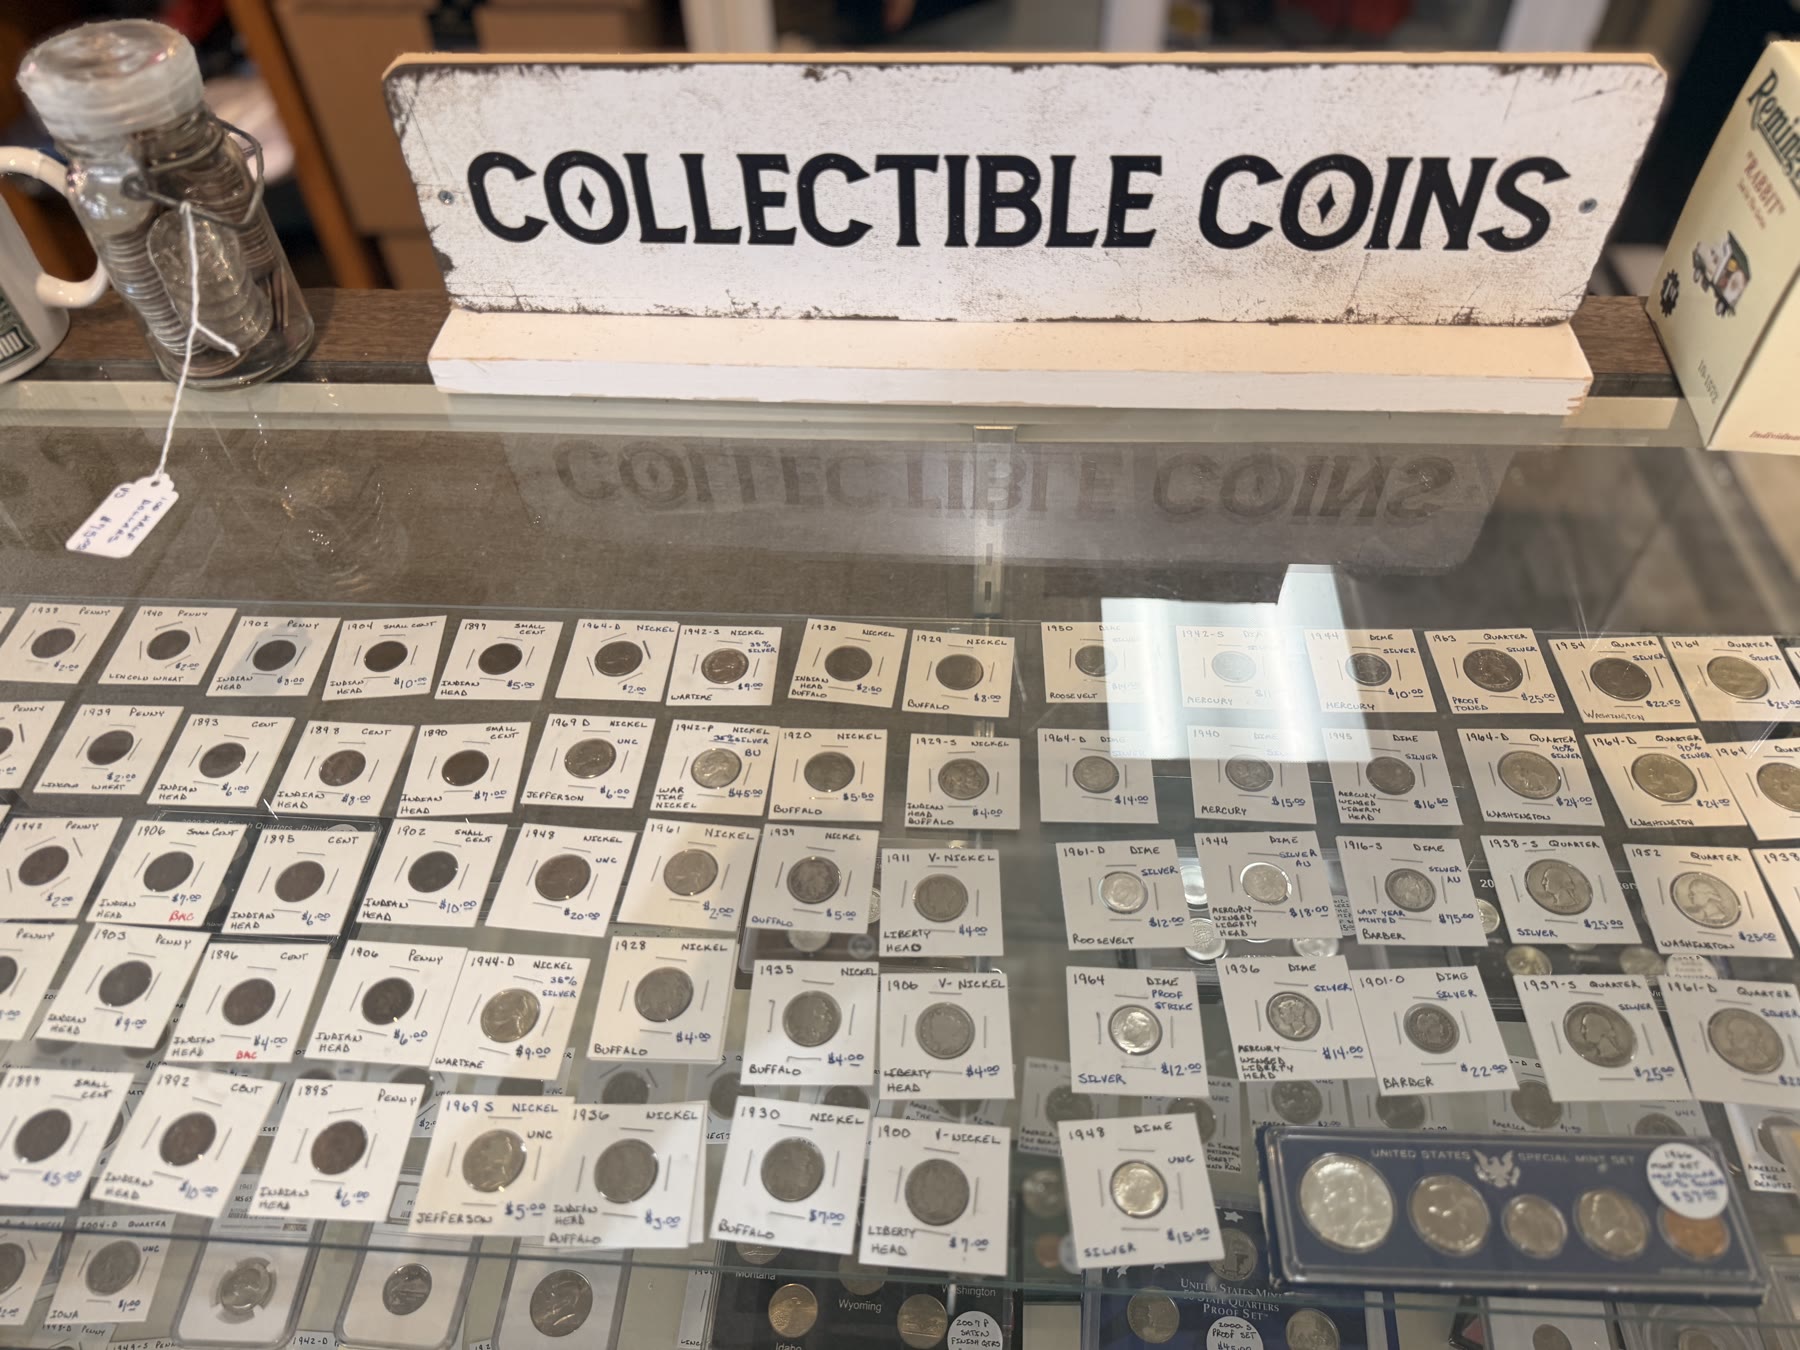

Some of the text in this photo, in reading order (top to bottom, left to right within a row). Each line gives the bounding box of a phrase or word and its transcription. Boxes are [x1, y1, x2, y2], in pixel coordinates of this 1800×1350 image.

[466, 150, 1571, 253] COLLECTIBLE COINS
[286, 620, 319, 629] PENNY
[347, 622, 373, 630] 1904
[916, 635, 1007, 646] 1929 NICKEL
[1610, 640, 1657, 648] QUARTER
[791, 689, 827, 698] BUFFALO
[1050, 692, 1098, 700] ROOSEVELT
[907, 700, 949, 710] BUFFALO
[1454, 704, 1488, 712] TONED
[129, 709, 166, 718] PENNY
[192, 718, 219, 727] 1893
[361, 728, 391, 736] CENT
[836, 732, 882, 740] NICKEL
[1529, 734, 1577, 744] QUARTER
[1655, 734, 1702, 744] QUARTER
[744, 749, 761, 757] BU
[1715, 747, 1747, 756] 1964
[158, 784, 197, 793] INDIAN
[526, 792, 584, 802] JEFFERSON
[656, 793, 684, 801] TIME
[400, 806, 430, 814] HEAD
[773, 805, 822, 816] BUFFALO
[1201, 805, 1247, 816] MERCURY
[1486, 811, 1552, 821] WASHINGTON
[397, 826, 426, 836] 1902
[704, 827, 755, 840] NICKEL
[328, 836, 359, 844] CENT
[583, 835, 622, 844] NICKEL
[1269, 835, 1298, 844] DIME
[1549, 839, 1600, 848] QUARTER
[1130, 846, 1161, 855] DIME
[1413, 842, 1445, 852] DIME
[886, 853, 910, 862] 1911
[1278, 849, 1318, 858] SILVER
[1690, 852, 1741, 861] QUARTER
[595, 856, 617, 864] UNC
[1295, 859, 1311, 867] AU
[1141, 866, 1178, 877] SILVER
[1428, 865, 1461, 873] SILVER
[1447, 876, 1461, 884] AU
[1212, 906, 1252, 914] MERCURY
[1357, 909, 1379, 917] LAST
[230, 912, 276, 921] INDIAN
[362, 911, 392, 921] HEAD
[751, 914, 794, 927] BUFFALO
[1213, 913, 1253, 921] WINGED
[1358, 915, 1396, 924] MINTED
[230, 921, 260, 929] HEAD
[1215, 919, 1257, 928] LIBERTY
[883, 928, 932, 939] LIBERTY
[1219, 929, 1249, 937] HEAD
[1362, 928, 1406, 941] BARBER
[1516, 928, 1558, 938] SILVER
[93, 930, 192, 948] 1903 PENNY
[1072, 934, 1134, 945] ROOSEVELT
[615, 940, 728, 951] 1928 NICKEL
[1660, 940, 1735, 950] WASHINGTON
[408, 949, 444, 964] PENNY
[533, 961, 573, 970] NICKEL
[1225, 963, 1317, 974] 1936 DIME
[1073, 974, 1179, 986] 1964 DIME
[1589, 980, 1641, 989] QUARTER
[1313, 983, 1352, 992] SILVER
[1736, 986, 1792, 998] QUARTER
[1151, 989, 1183, 1000] PROOF
[1436, 989, 1477, 998] SILVER
[1154, 1002, 1193, 1011] STRIKE
[318, 1043, 351, 1052] HEAD
[1238, 1044, 1281, 1053] MERCURY
[435, 1058, 484, 1068] WARTIME
[749, 1064, 802, 1076] BUFFALO
[1241, 1064, 1294, 1072] LIBERTY
[884, 1068, 932, 1078] LIBERTY
[1078, 1073, 1126, 1084] SILVER
[1383, 1076, 1434, 1089] BARBER
[887, 1082, 921, 1092] HEAD
[511, 1102, 559, 1113] NICKEL
[646, 1111, 698, 1120] NICKEL
[741, 1107, 864, 1125] 1930 NICKEL
[878, 1125, 911, 1138] 1900
[1133, 1121, 1172, 1134] DIME
[527, 1130, 553, 1139] UNC
[1168, 1155, 1194, 1163] UNC
[1371, 1149, 1635, 1165] UNITED STATES SPECIAL MINT SET
[416, 1211, 493, 1224] JEFFERSON
[718, 1219, 775, 1239] BUFFALO
[868, 1225, 917, 1239] LIBERTY
[1083, 1242, 1136, 1258] SILVER
[942, 1284, 996, 1298] Wshington
[838, 1299, 882, 1313] Wyoming
[1228, 1300, 1280, 1313] QUARTERS
[51, 1310, 79, 1319] IOWA
[951, 1338, 979, 1346] FINISH
